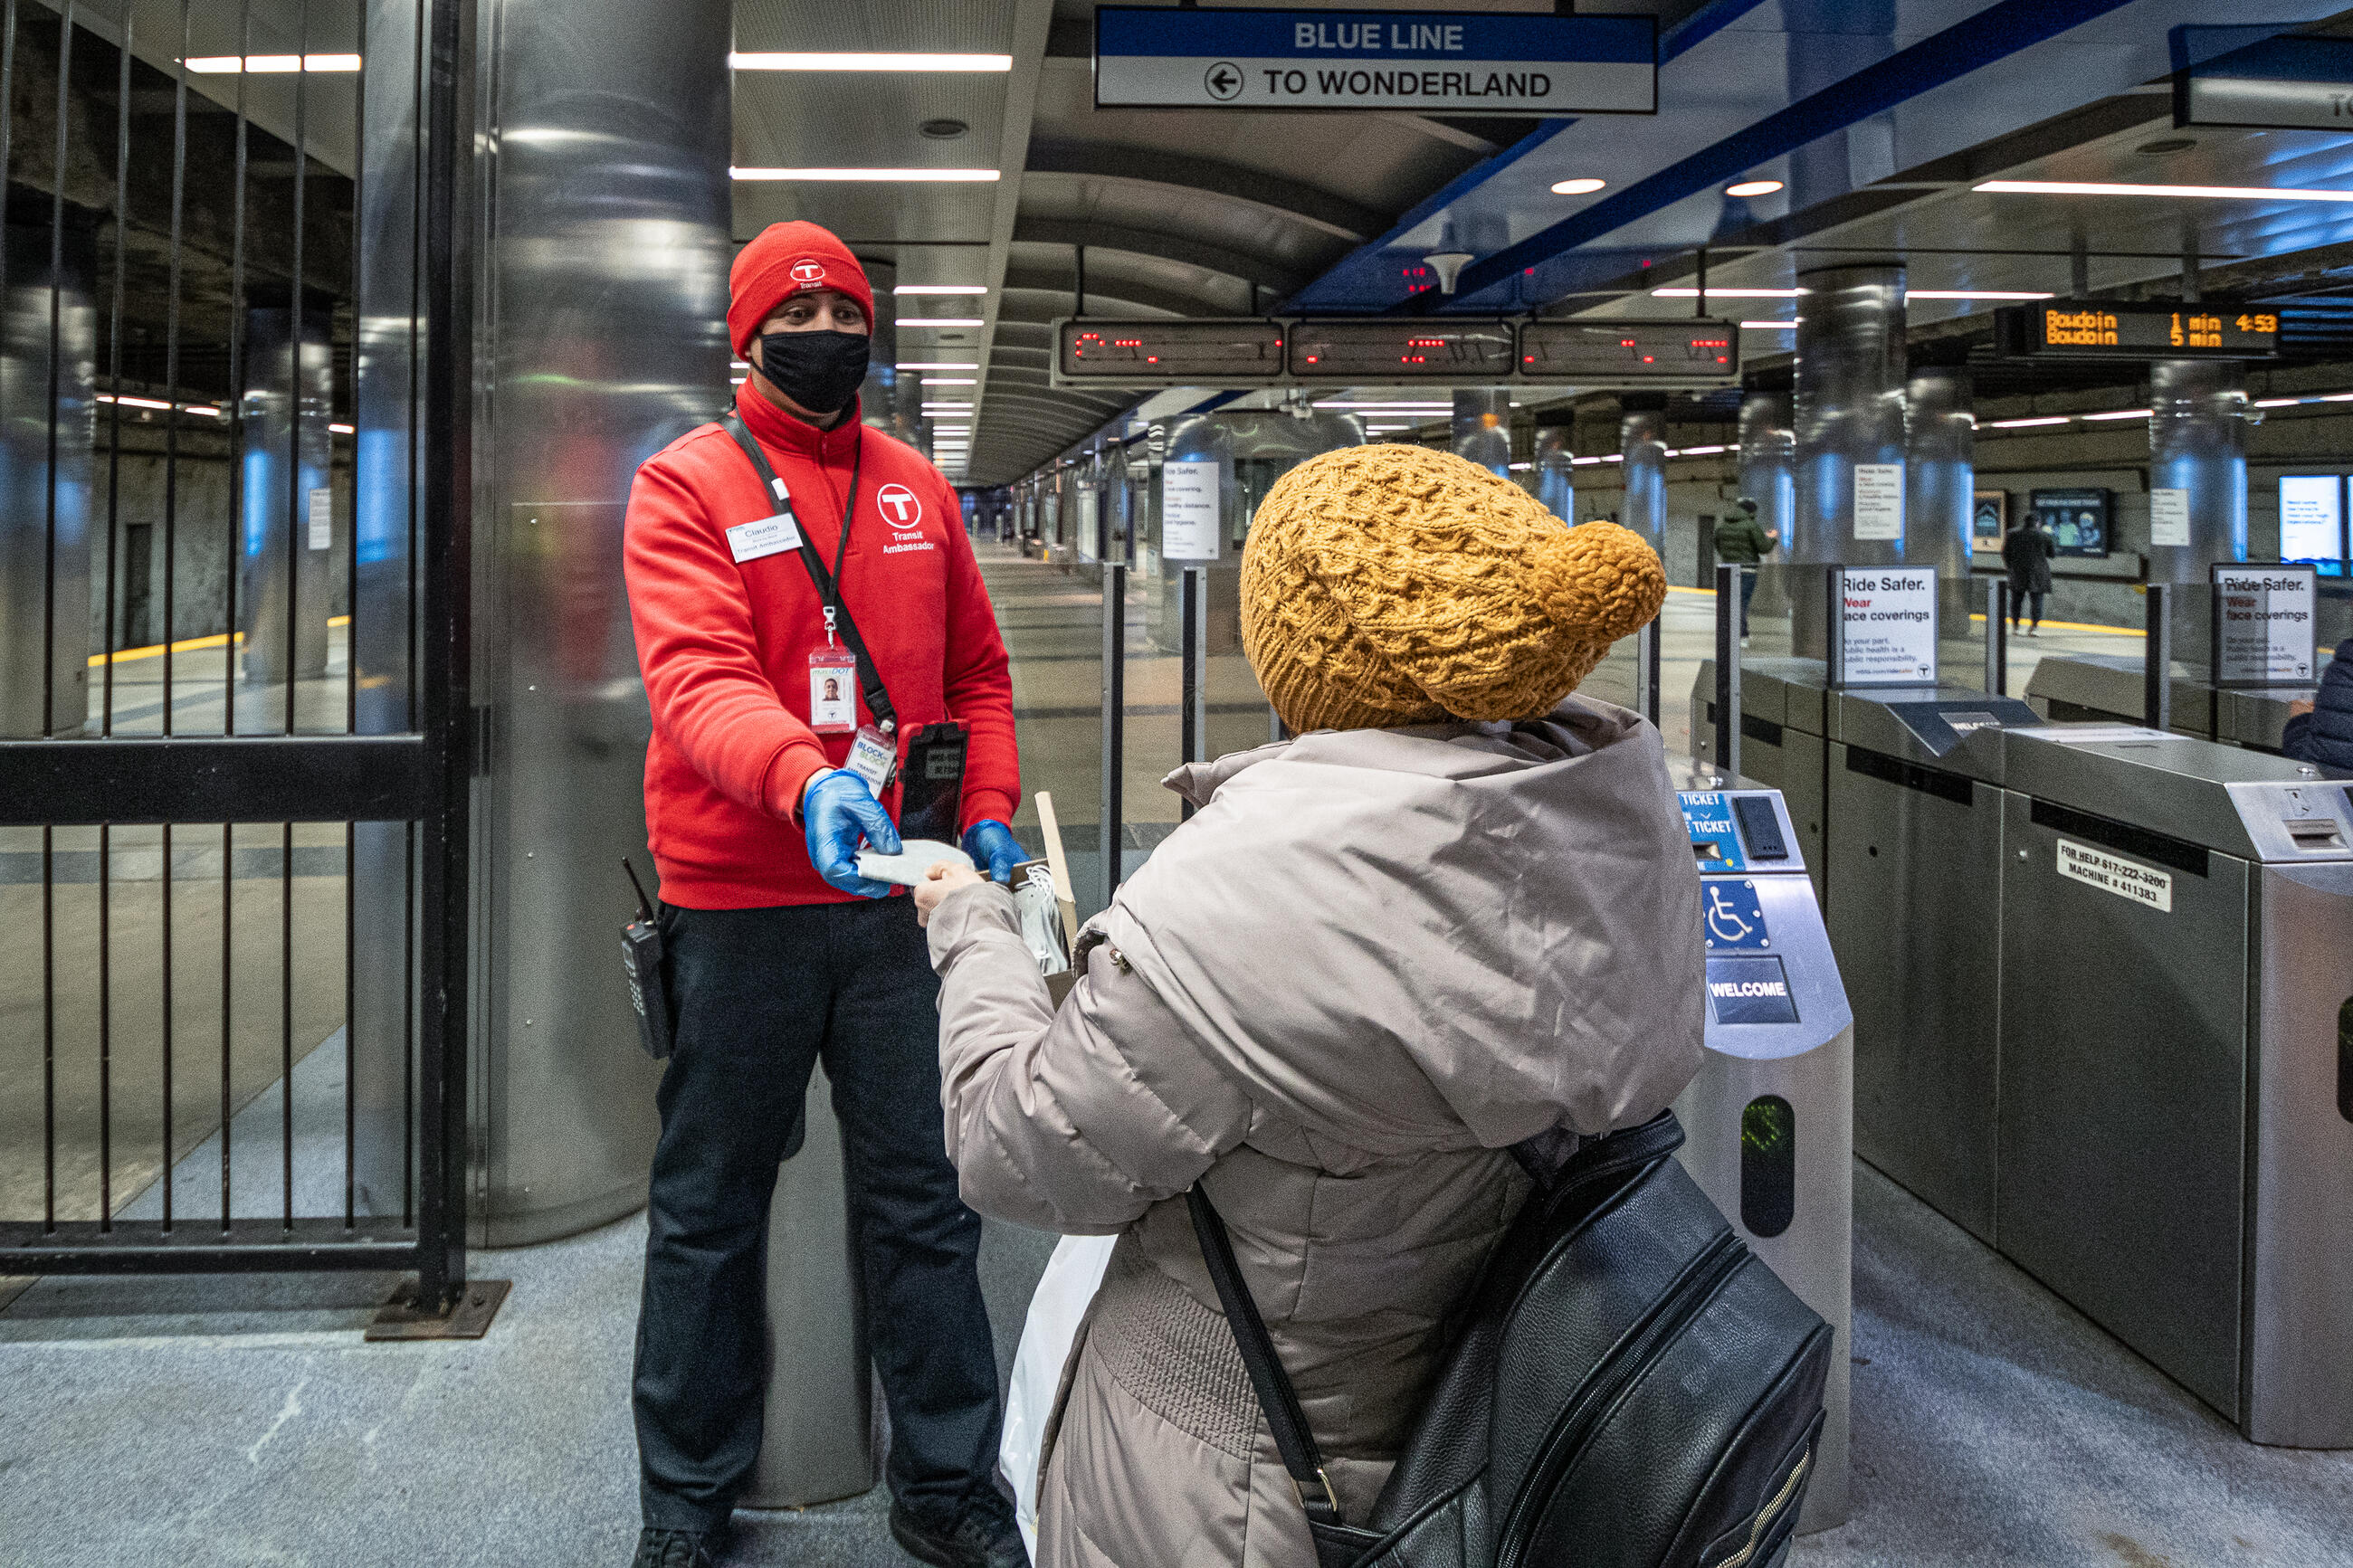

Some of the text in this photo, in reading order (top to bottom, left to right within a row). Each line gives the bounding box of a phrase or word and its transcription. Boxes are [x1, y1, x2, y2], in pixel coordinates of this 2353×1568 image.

[1294, 23, 1463, 51] BLUE LINE
[1262, 70, 1550, 97] TO WONDERLAND
[2329, 93, 2353, 117] T
[800, 280, 822, 289] Transit
[2188, 312, 2222, 331] min
[2235, 313, 2278, 333] 4:53
[2170, 329, 2184, 347] 5
[2188, 332, 2223, 347] min
[745, 524, 778, 537] Claudio
[891, 530, 923, 541] Transit
[883, 541, 934, 554] Ambassador
[1843, 577, 1925, 592] Ride Safer.
[2224, 578, 2304, 591] Ride Safer.
[2227, 597, 2256, 607] Wear
[1843, 610, 1929, 622] ace coverings
[2227, 610, 2308, 622] face coverings
[857, 741, 883, 758] BLOCK
[860, 751, 886, 767] BLOCK
[1681, 794, 1720, 805] TICKET
[1692, 821, 1731, 833] TICKET
[2062, 845, 2166, 889] FOR HELP 617-222-3200
[2069, 862, 2109, 885] MACHINE
[2120, 881, 2158, 902] 411383
[1710, 982, 1786, 997] WELCOME
